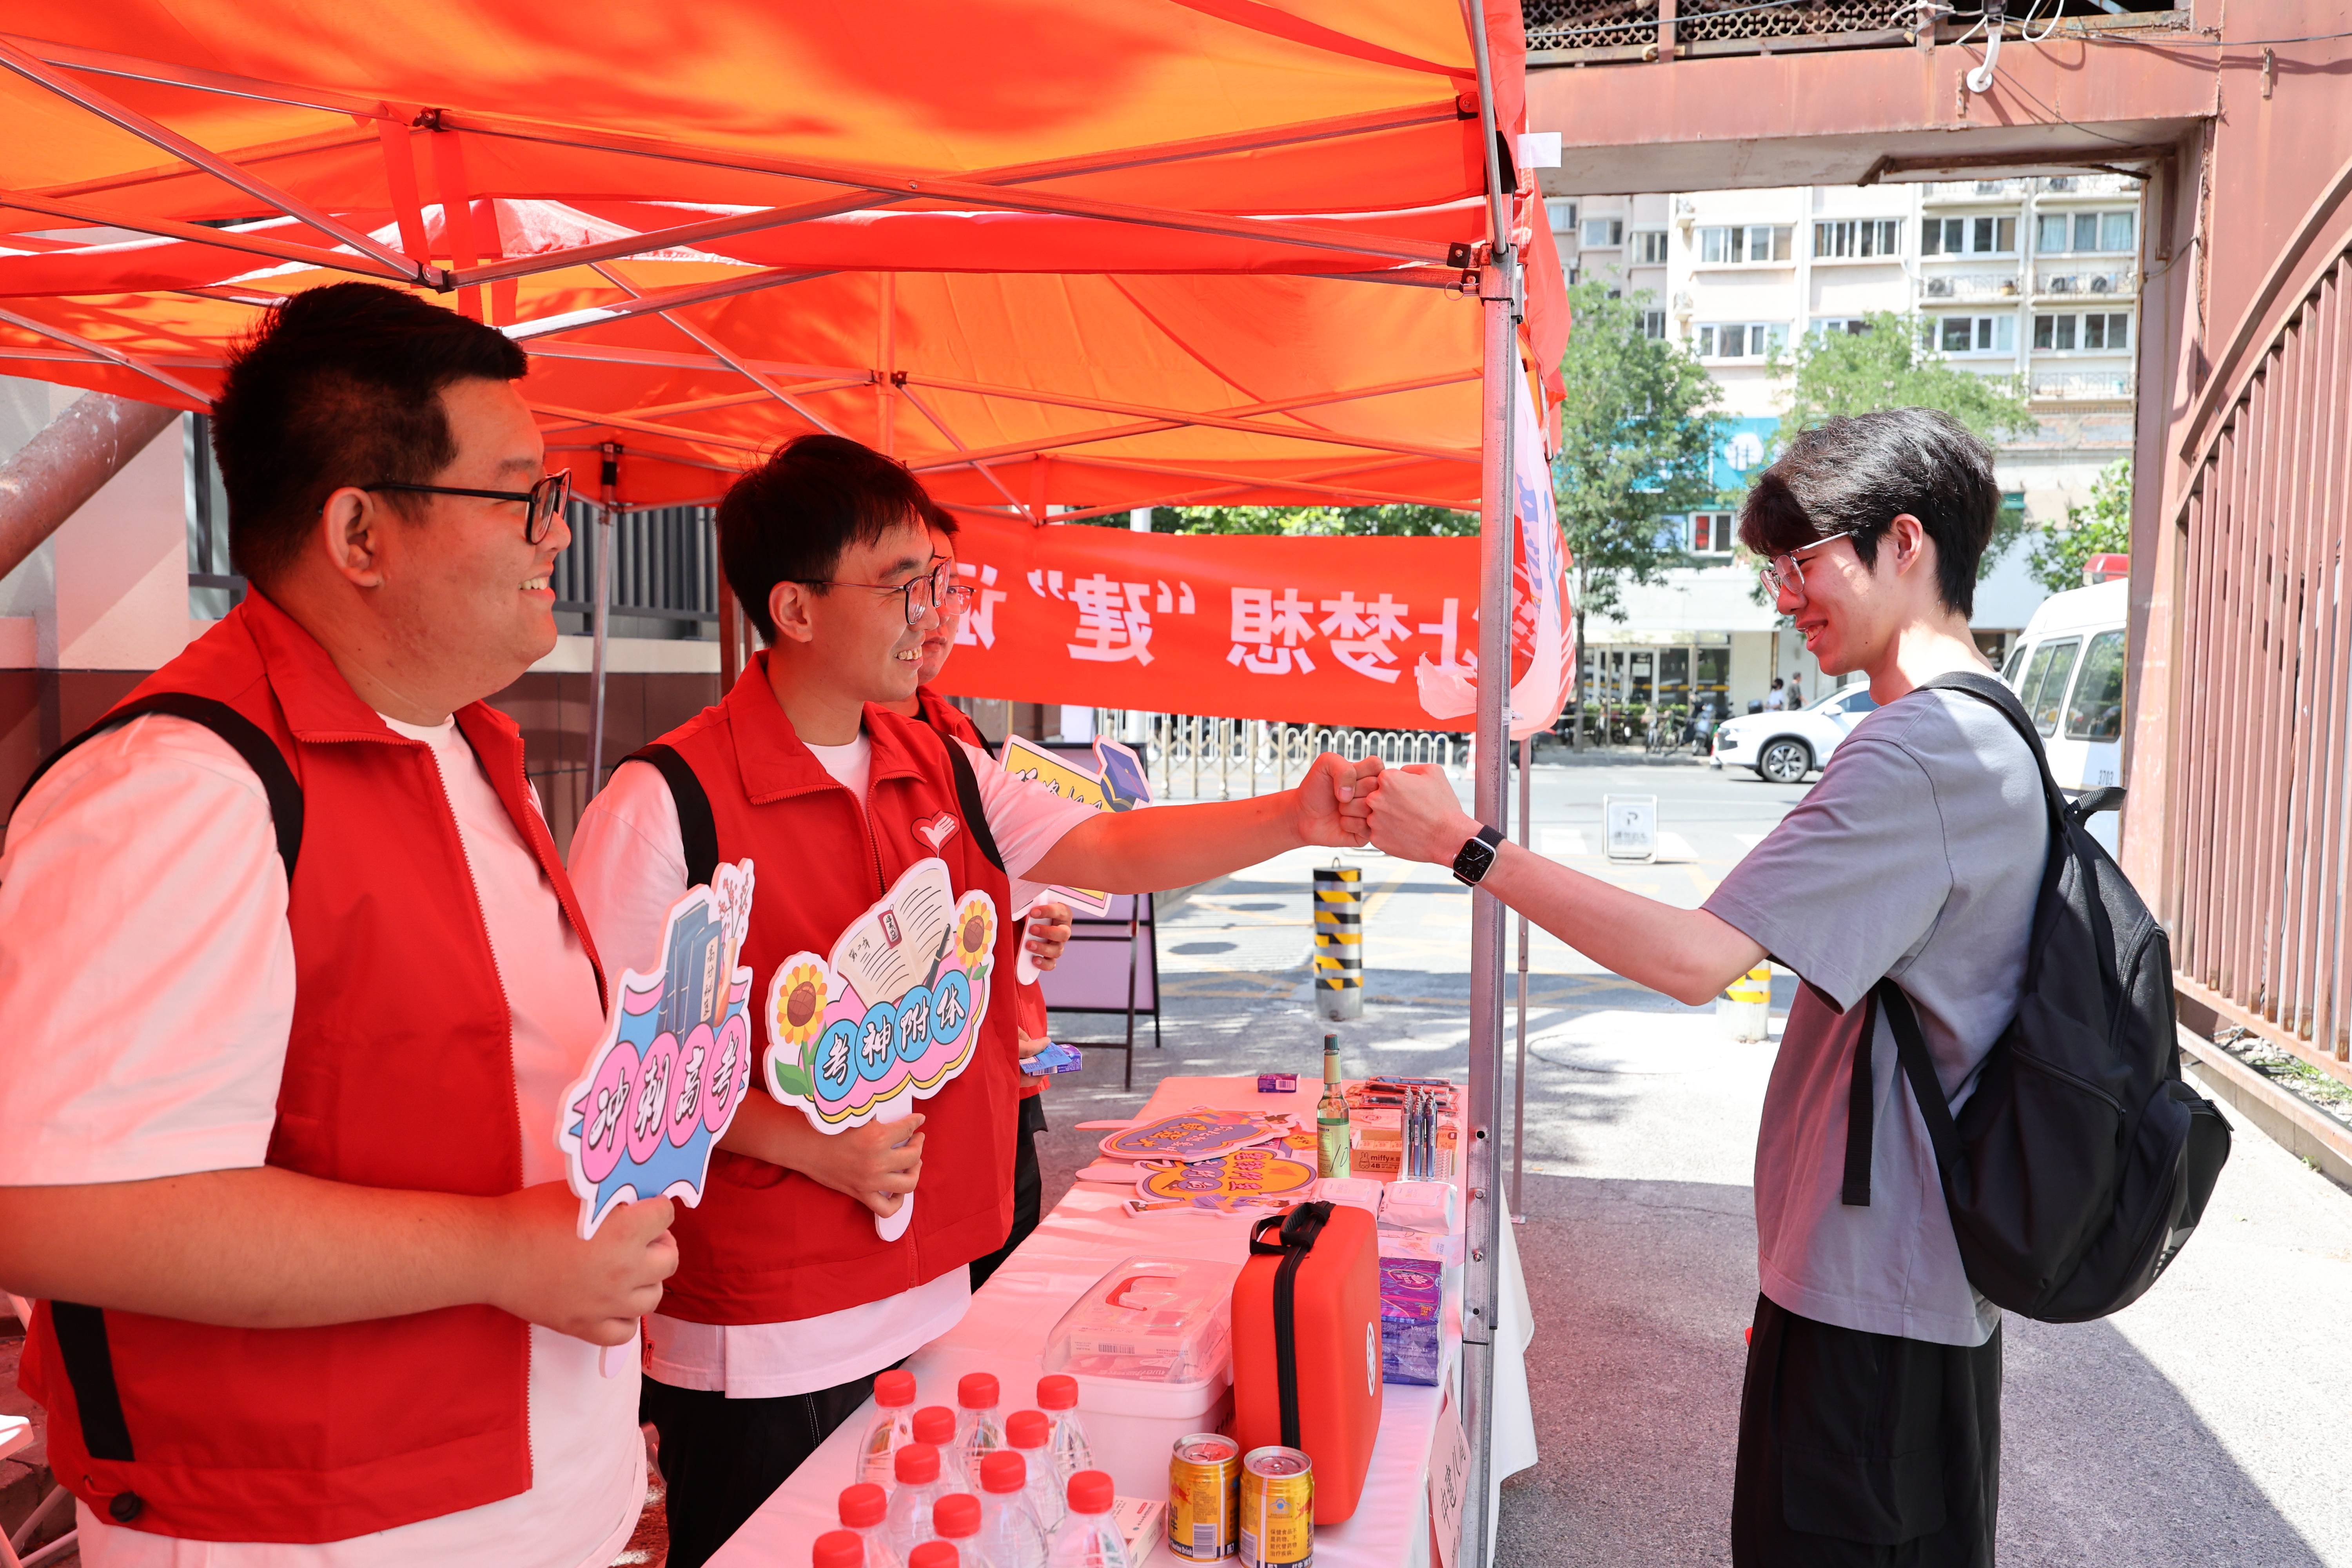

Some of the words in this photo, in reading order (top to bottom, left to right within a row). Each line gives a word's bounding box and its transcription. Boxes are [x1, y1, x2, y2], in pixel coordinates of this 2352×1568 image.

[2098, 769, 2114, 786] 3703
[822, 982, 966, 1086] 考神附体
[588, 1031, 740, 1151] 冲刺高考
[1229, 1152, 1267, 1191] 笔锋所至
[1181, 1546, 1192, 1556] Drink
